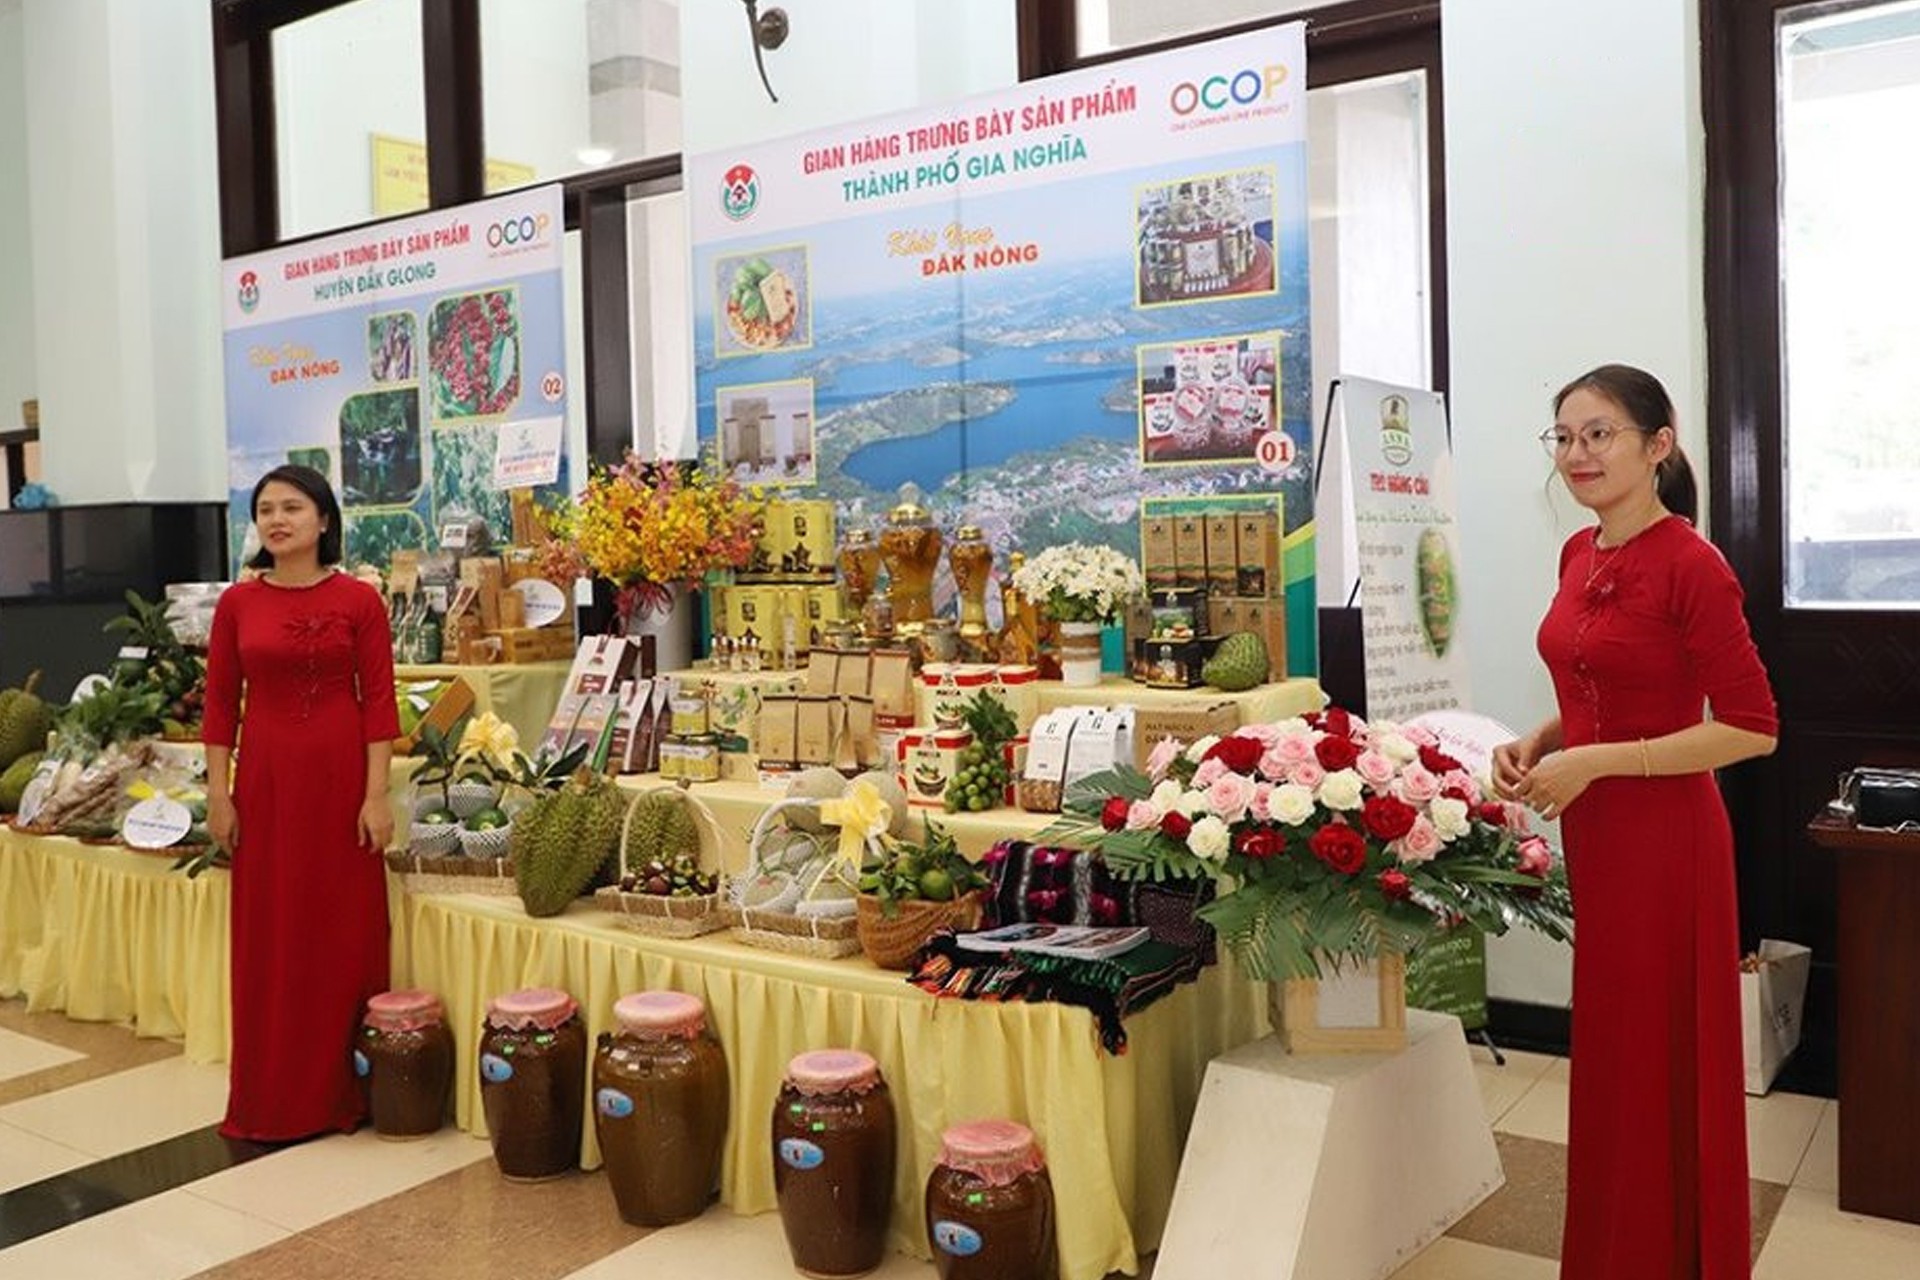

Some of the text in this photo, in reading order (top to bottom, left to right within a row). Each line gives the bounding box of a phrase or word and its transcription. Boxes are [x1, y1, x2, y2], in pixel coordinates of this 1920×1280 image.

[1171, 64, 1289, 116] OCOP
[803, 78, 1137, 175] GIAN HÀNG TRƯNG BÀY SẢN PHẨM
[842, 133, 1088, 203] THÀNH PHỐ GIA NGHĨA
[486, 211, 550, 249] OCOP
[973, 243, 1039, 269] NÔNG
[284, 259, 311, 280] GIAN
[387, 261, 437, 287] GLONG
[543, 378, 562, 396] 02
[1262, 441, 1290, 463] 01
